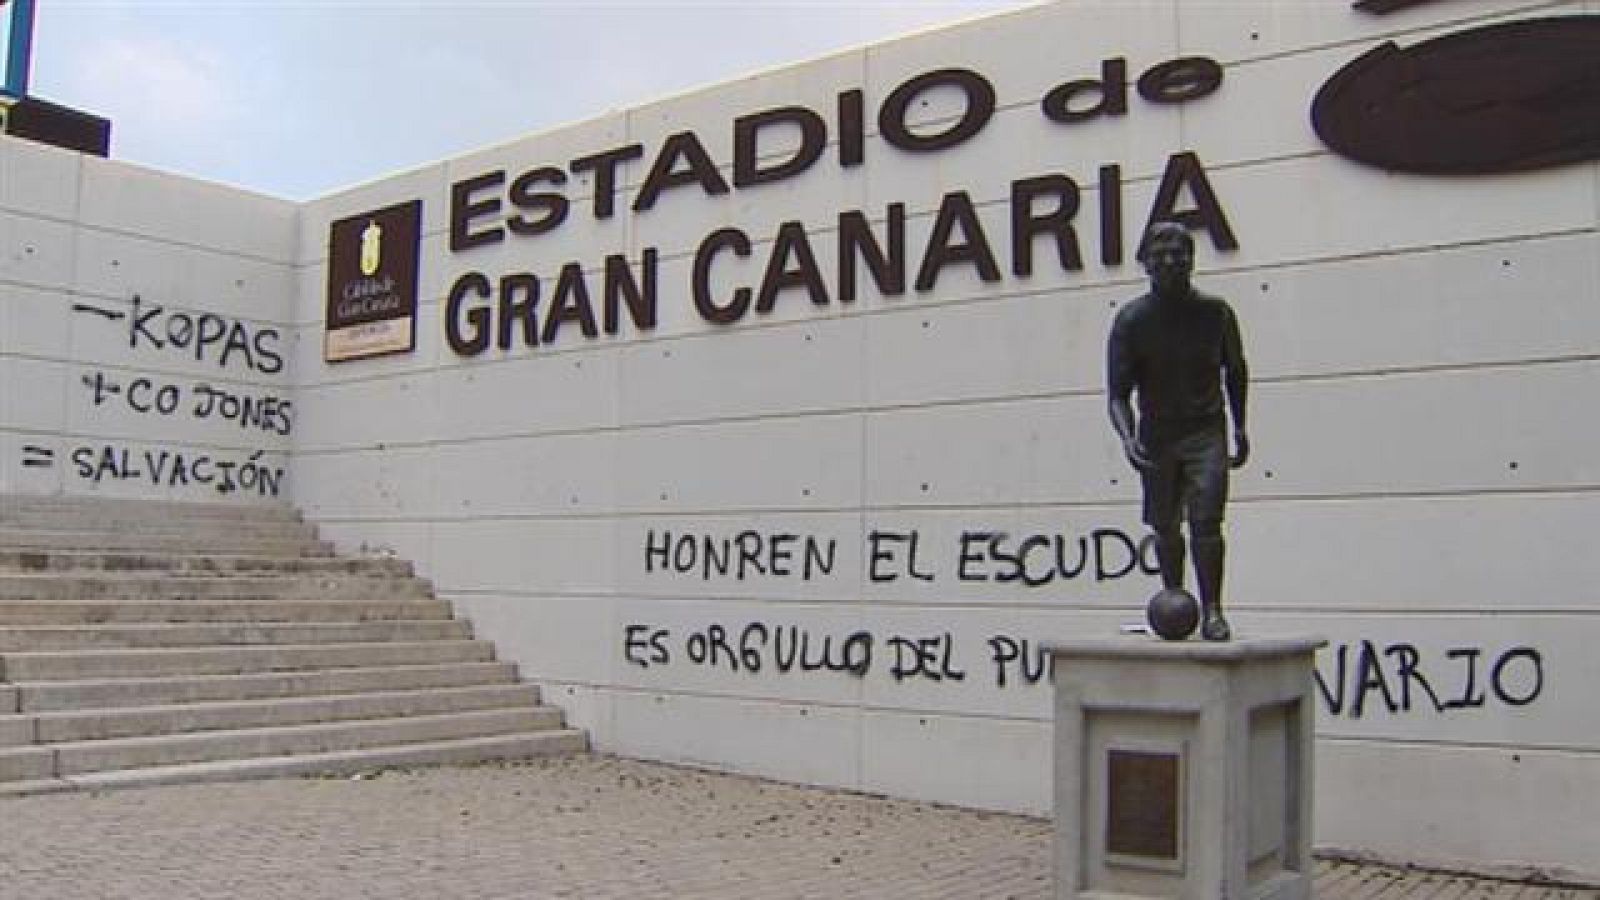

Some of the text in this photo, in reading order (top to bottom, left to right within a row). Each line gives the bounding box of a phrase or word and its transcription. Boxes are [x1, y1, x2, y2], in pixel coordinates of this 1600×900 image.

[450, 56, 1224, 252] ESTADIO de
[445, 150, 1240, 357] GRAN CANARIA
[645, 529, 836, 581] HONREN
[868, 529, 935, 583] EL
[625, 624, 670, 669] ES
[686, 621, 874, 677] ORGULLO
[887, 632, 965, 684] DEL
